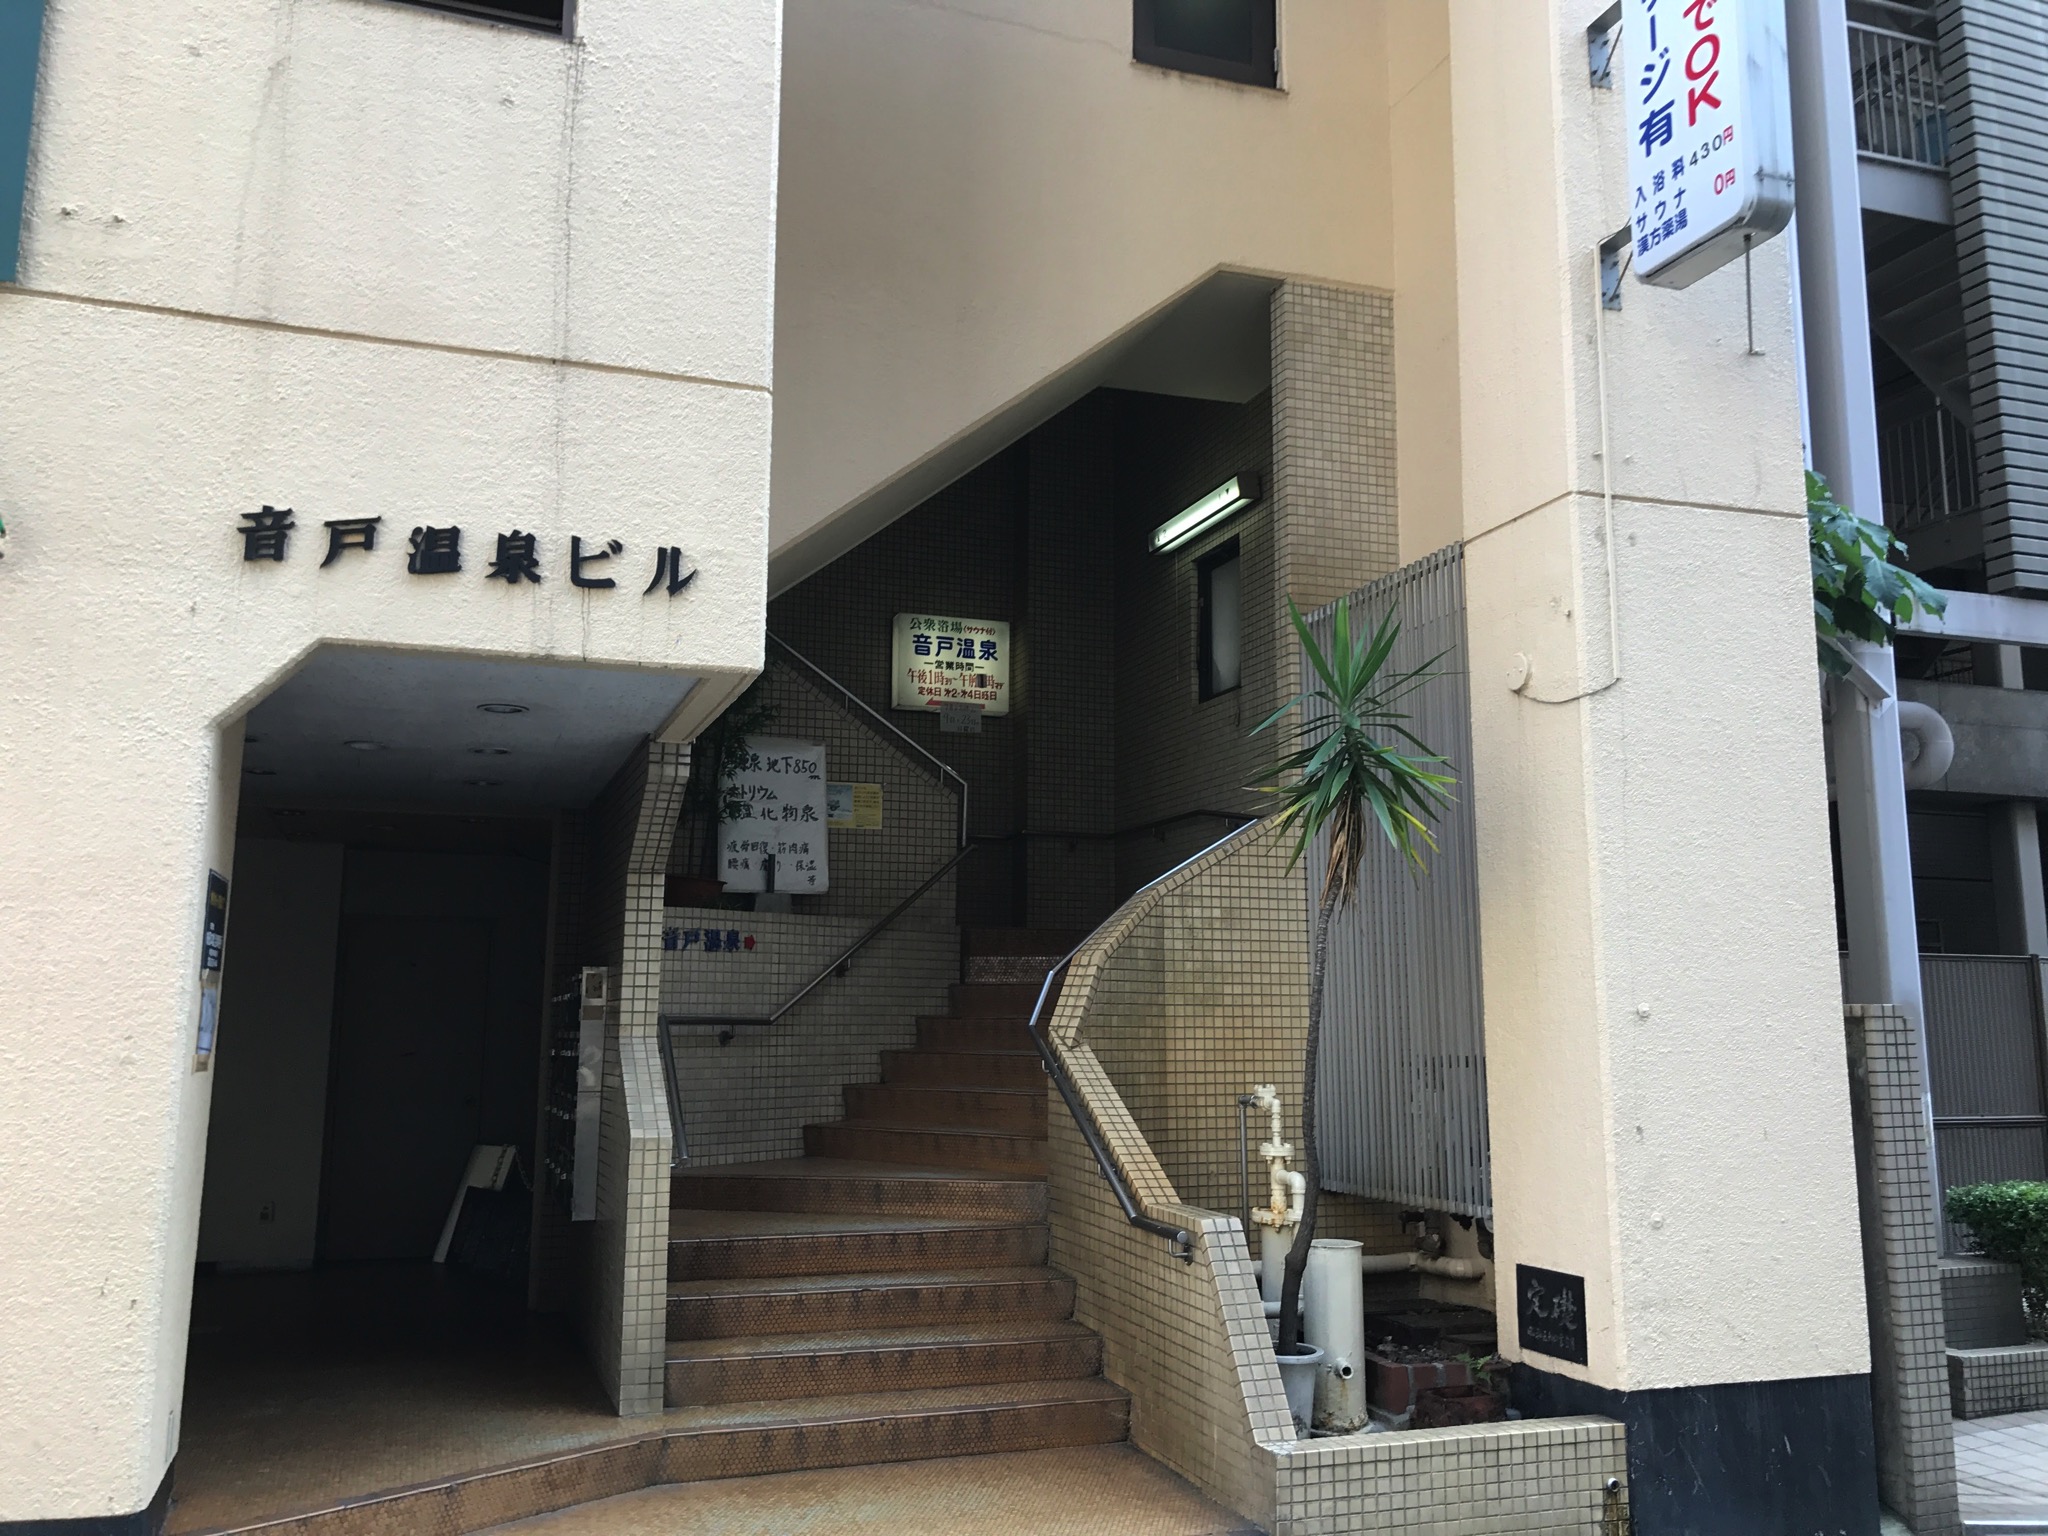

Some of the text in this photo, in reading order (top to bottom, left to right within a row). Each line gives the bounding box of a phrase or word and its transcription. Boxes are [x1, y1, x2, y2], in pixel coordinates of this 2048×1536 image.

[1639, 0, 1675, 157] ージ有
[237, 505, 699, 597] 音戸温泉ビル
[912, 633, 998, 661] 音戸温泉
[661, 926, 741, 952] 音戸温泉
